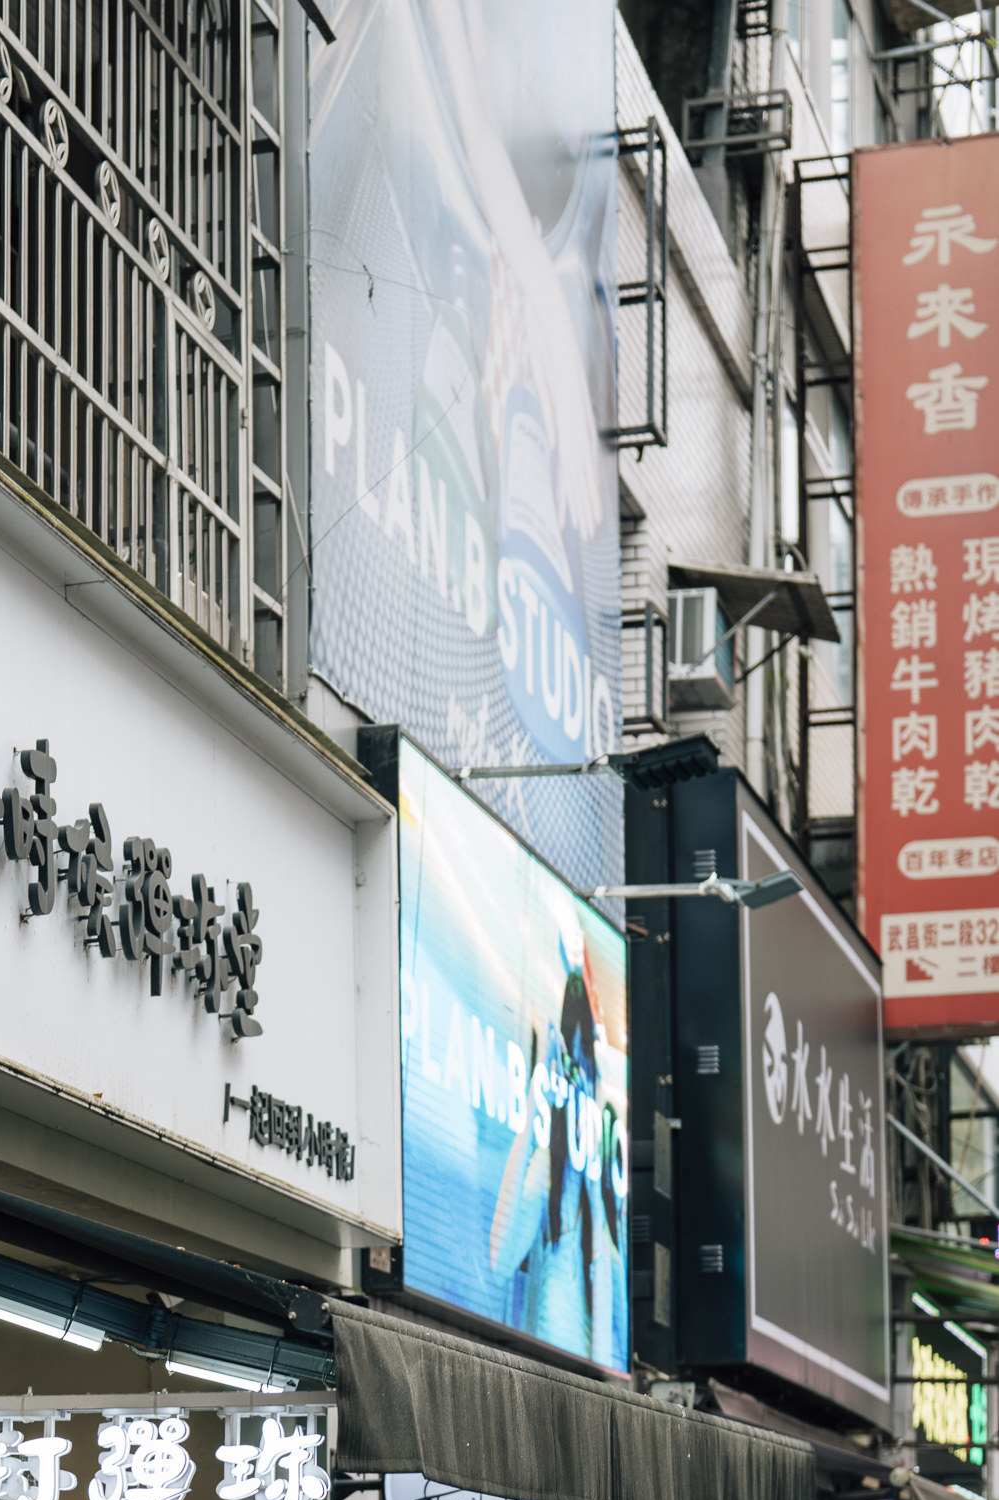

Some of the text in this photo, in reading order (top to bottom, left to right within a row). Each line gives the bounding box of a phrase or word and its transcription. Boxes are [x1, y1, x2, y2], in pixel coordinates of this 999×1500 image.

[901, 203, 998, 435] 永來香
[324, 341, 490, 638] PLAN.B
[496, 556, 615, 757] STUDIO
[890, 542, 939, 816] 熱銷牛肉乾
[904, 847, 998, 872] 百年老店
[400, 967, 630, 1199] PLAN.B STUDIO
[790, 1019, 875, 1199] 水水生活
